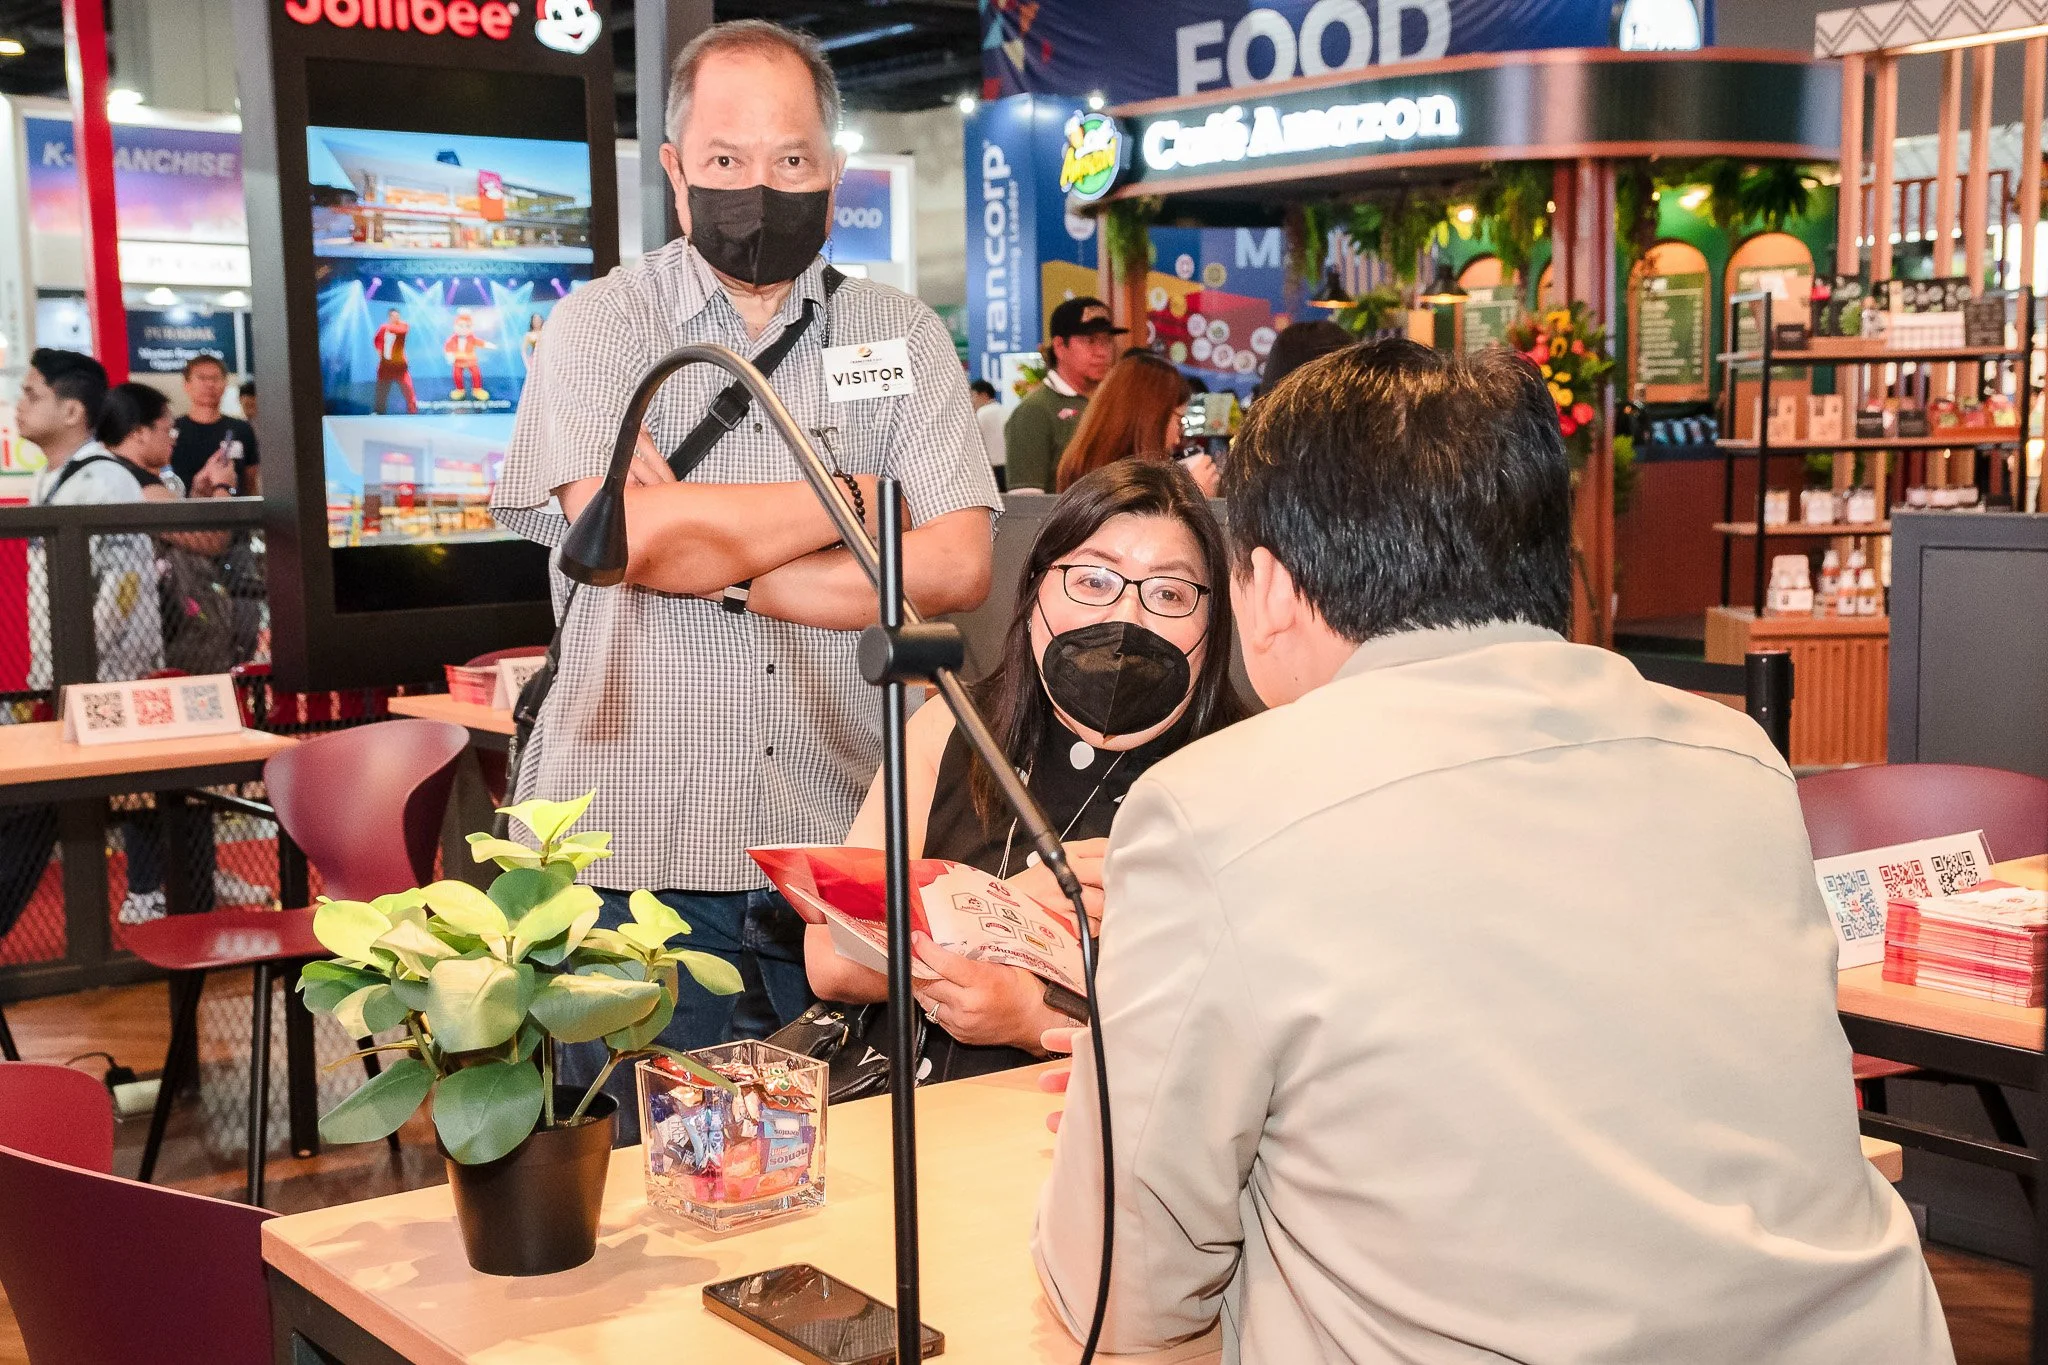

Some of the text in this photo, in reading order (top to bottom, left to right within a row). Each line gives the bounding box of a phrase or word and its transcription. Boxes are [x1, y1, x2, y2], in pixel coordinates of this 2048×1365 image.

[1176, 0, 1452, 95] FOOD
[1246, 94, 1460, 157] Amazon
[43, 141, 236, 178] K-ANCHISE
[982, 144, 1012, 391] Francorp
[833, 367, 904, 386] VISITOR
